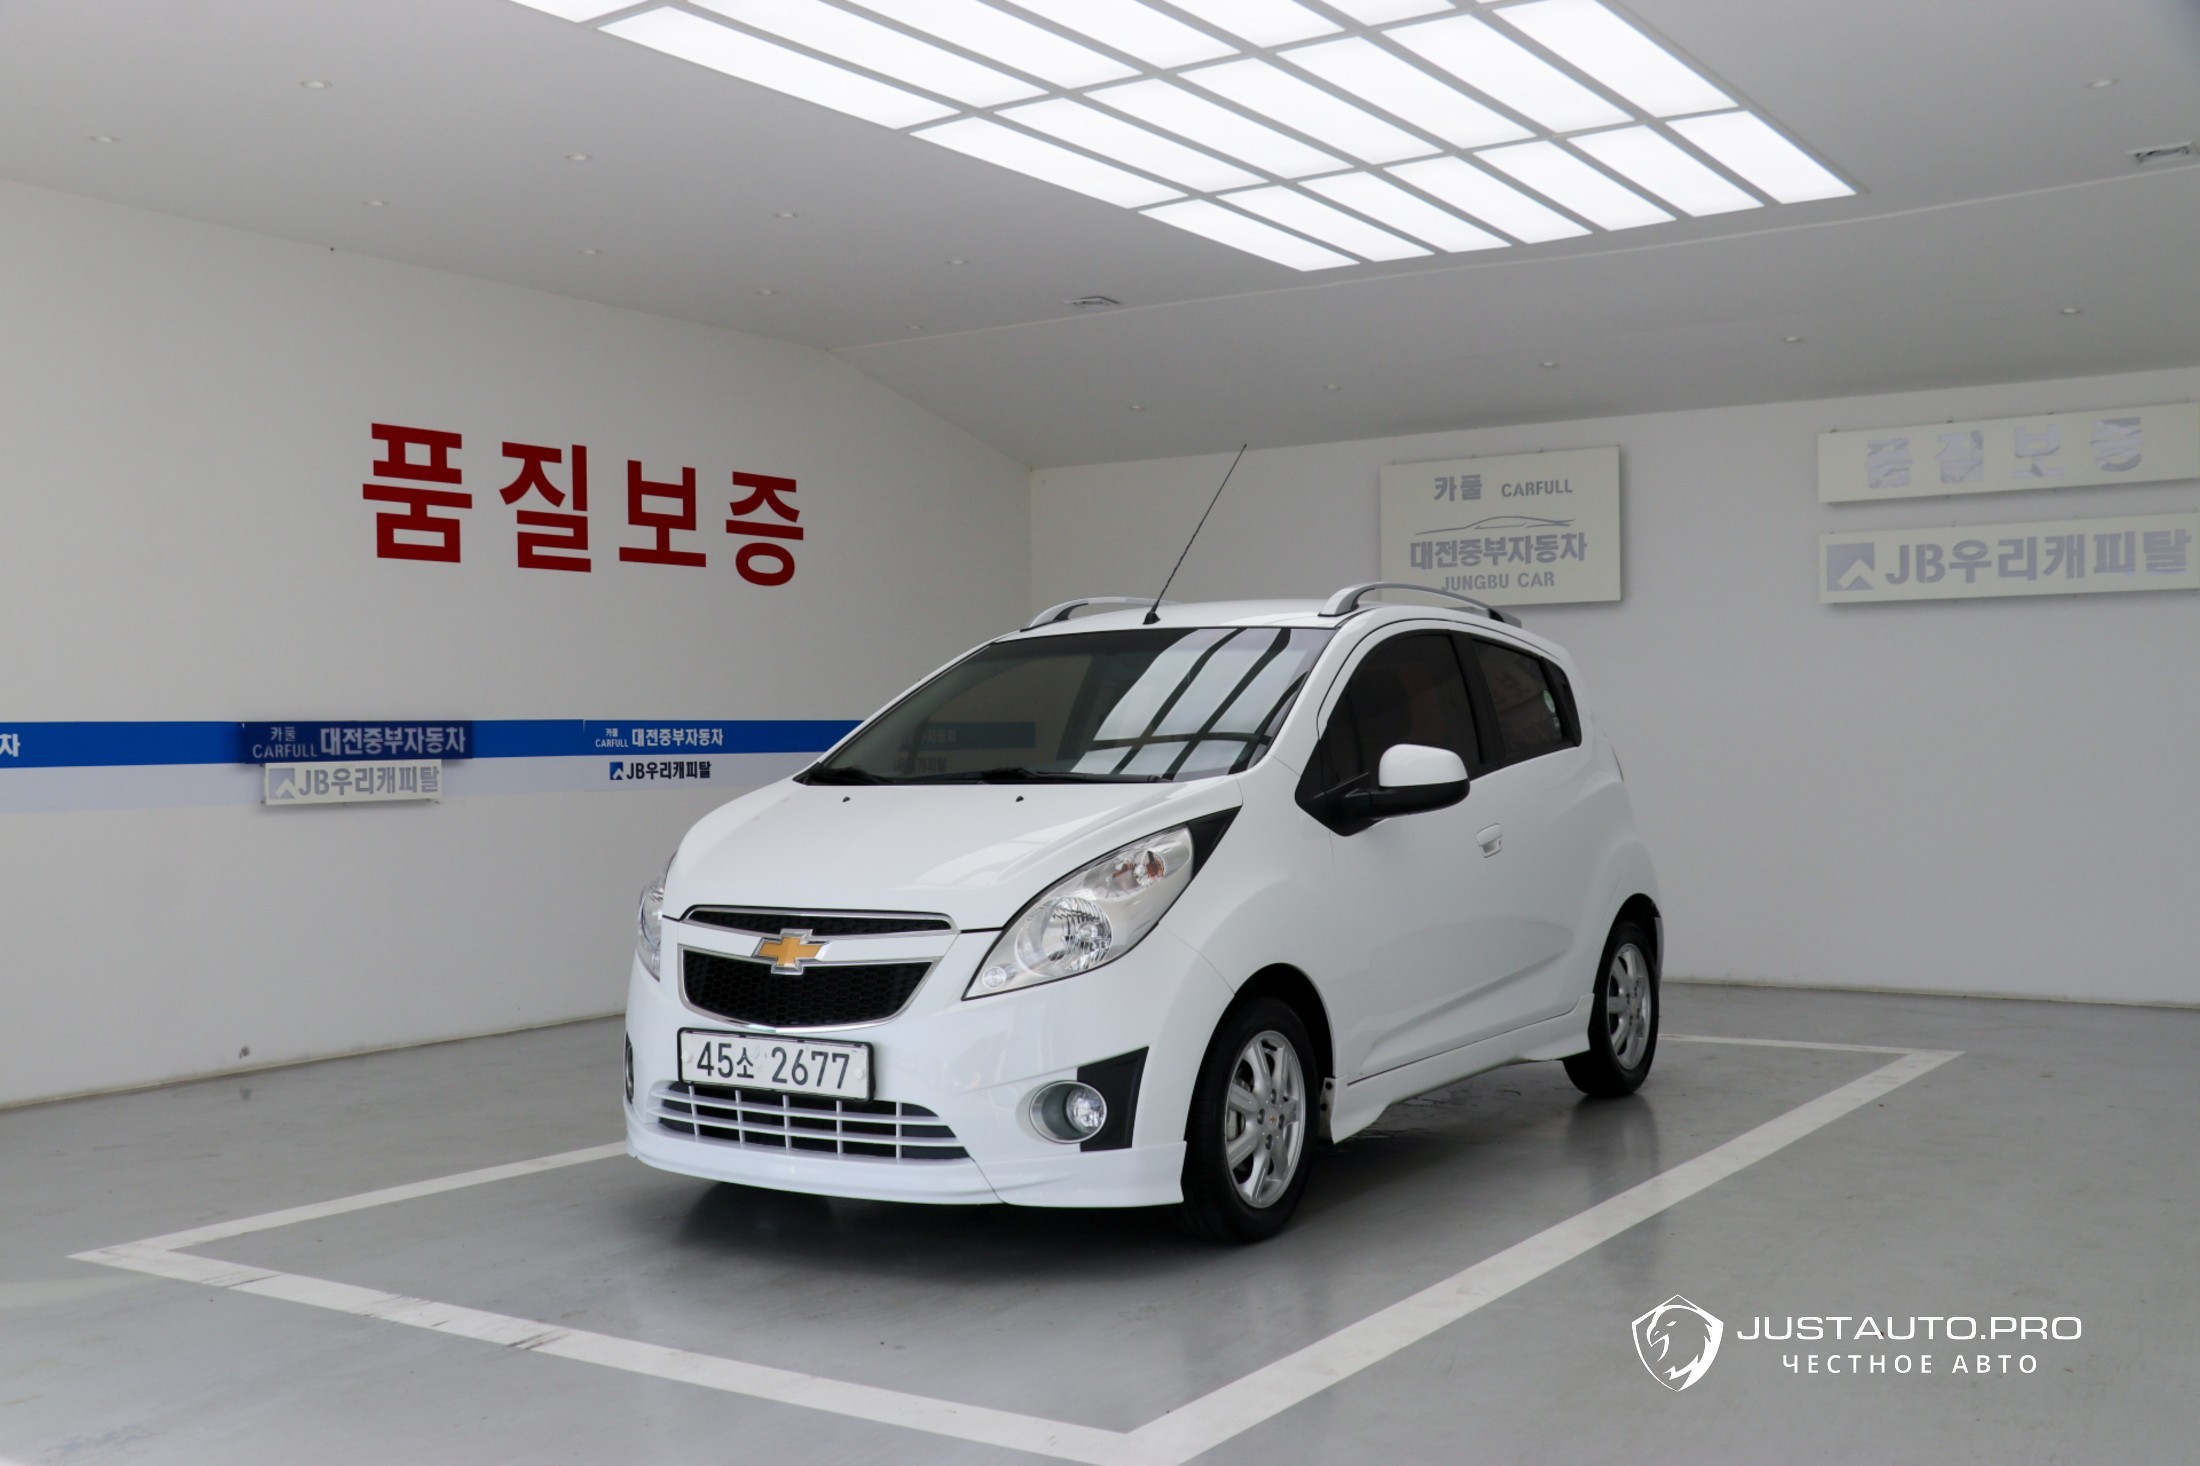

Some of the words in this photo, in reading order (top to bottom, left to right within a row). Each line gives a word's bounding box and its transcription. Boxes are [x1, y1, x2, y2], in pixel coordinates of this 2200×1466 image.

[1433, 474, 1482, 501] 카풀
[1501, 479, 1573, 497] CARFULL
[362, 423, 805, 586] 품질보증
[1409, 532, 1588, 570] 대전중부자동차
[1885, 529, 2192, 584] JB우리캐피탈
[1442, 574, 1510, 592] JUNGBU
[1517, 571, 1555, 588] CAR
[270, 726, 297, 742] 카풀
[320, 726, 466, 755] 대전중부자동차
[595, 739, 629, 748] CARFULL
[632, 728, 724, 747] 대전중부자동차
[252, 744, 318, 759] CARFULL
[298, 766, 440, 796] JB우리캐피탈
[626, 761, 712, 780] JB우리캐피탈
[696, 1041, 755, 1079] 45소
[771, 1046, 850, 1090] 2677
